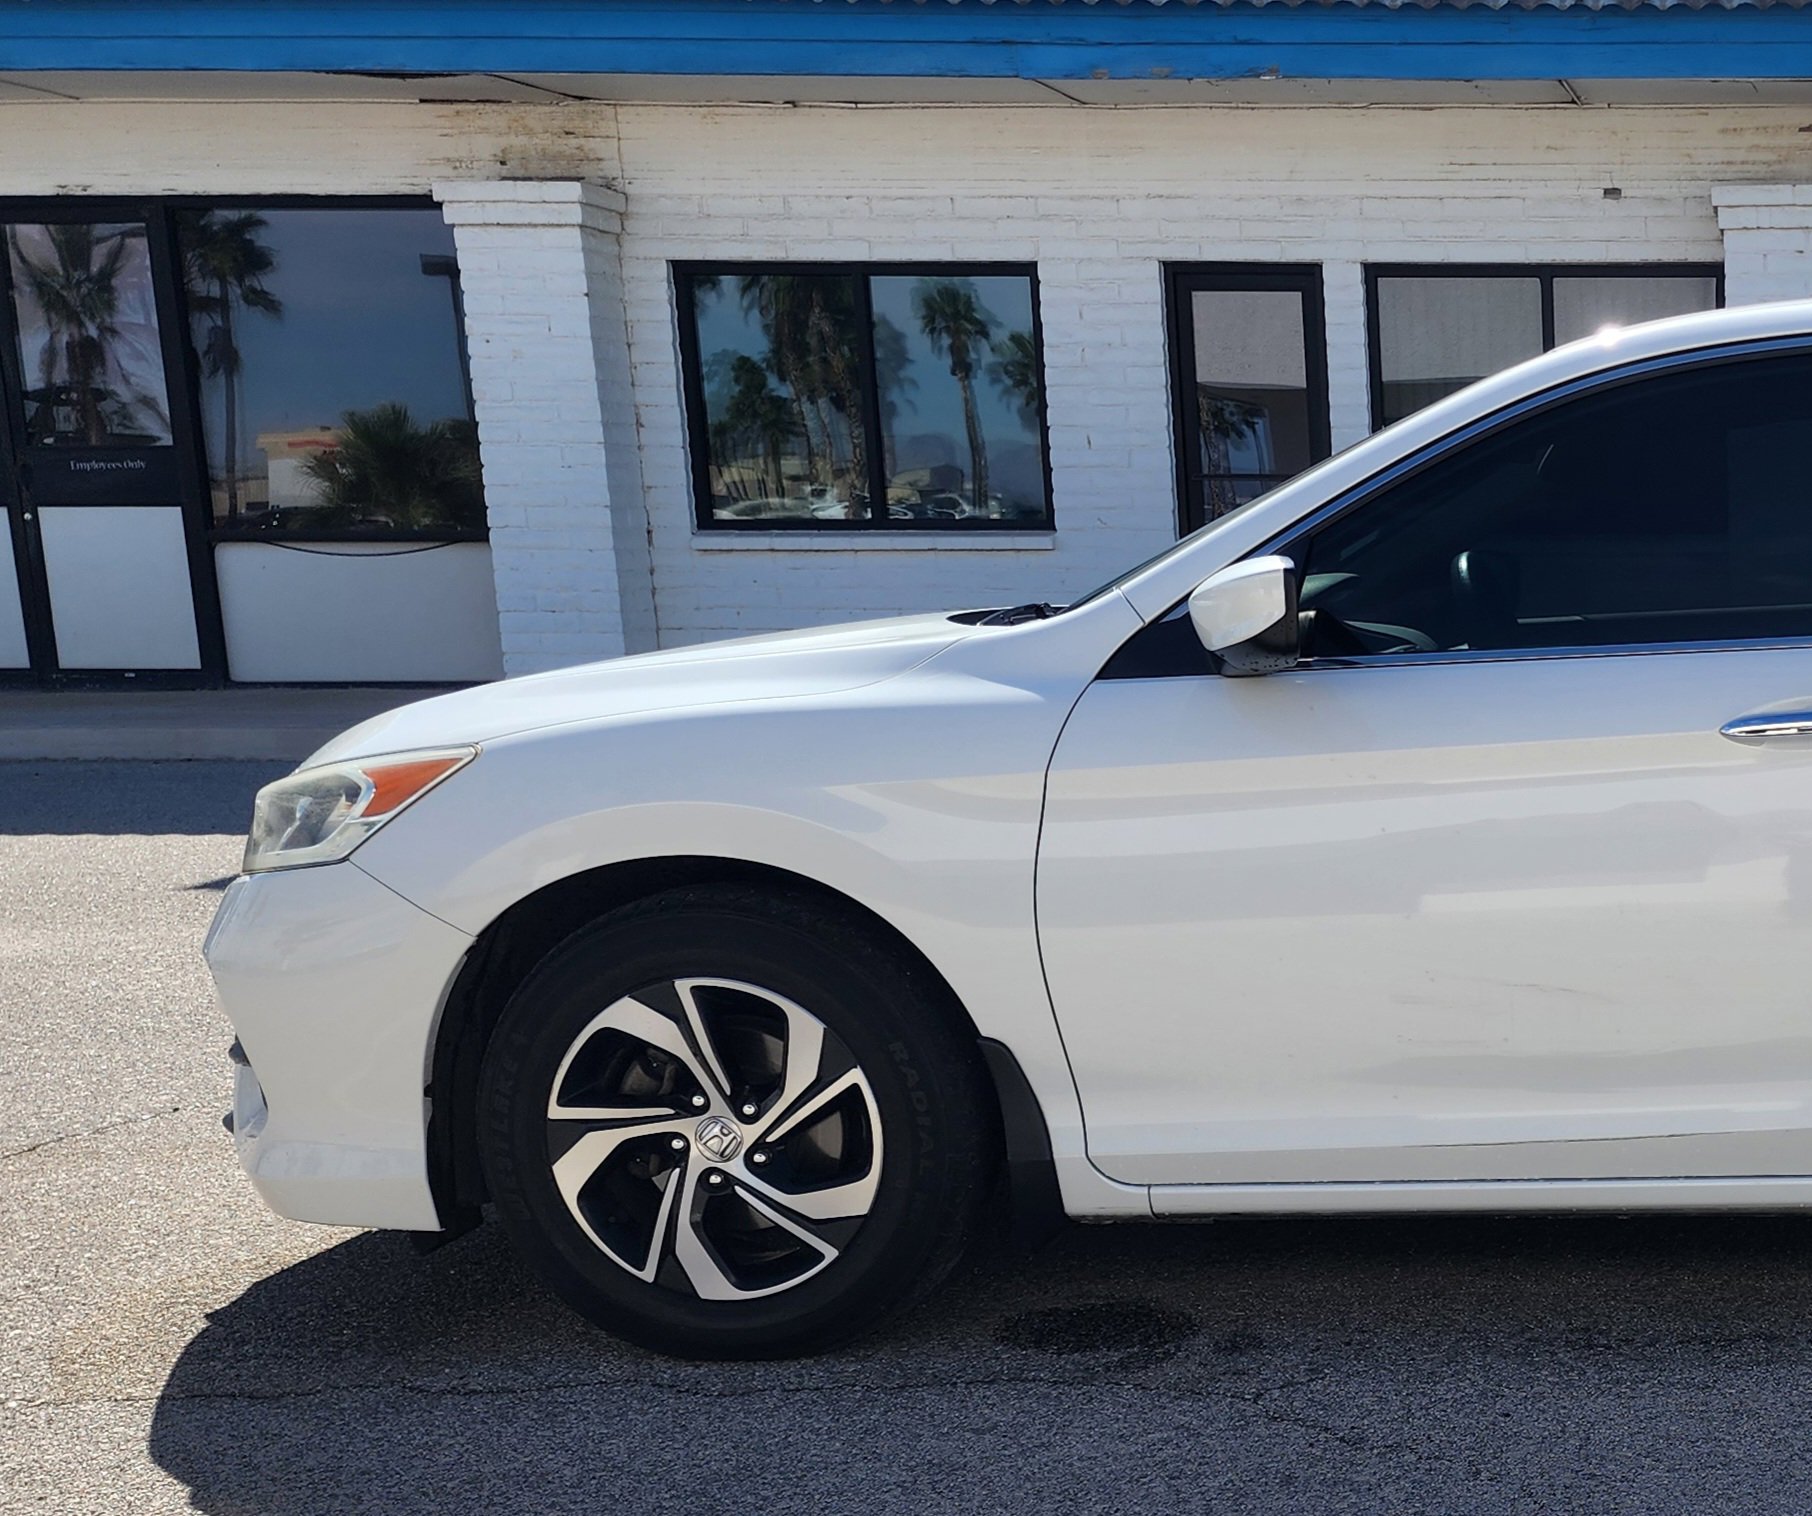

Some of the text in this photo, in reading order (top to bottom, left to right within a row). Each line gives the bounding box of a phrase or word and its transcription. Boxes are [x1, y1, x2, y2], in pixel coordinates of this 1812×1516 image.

[70, 459, 146, 472] Employees Only
[887, 1040, 936, 1177] RADIAL
